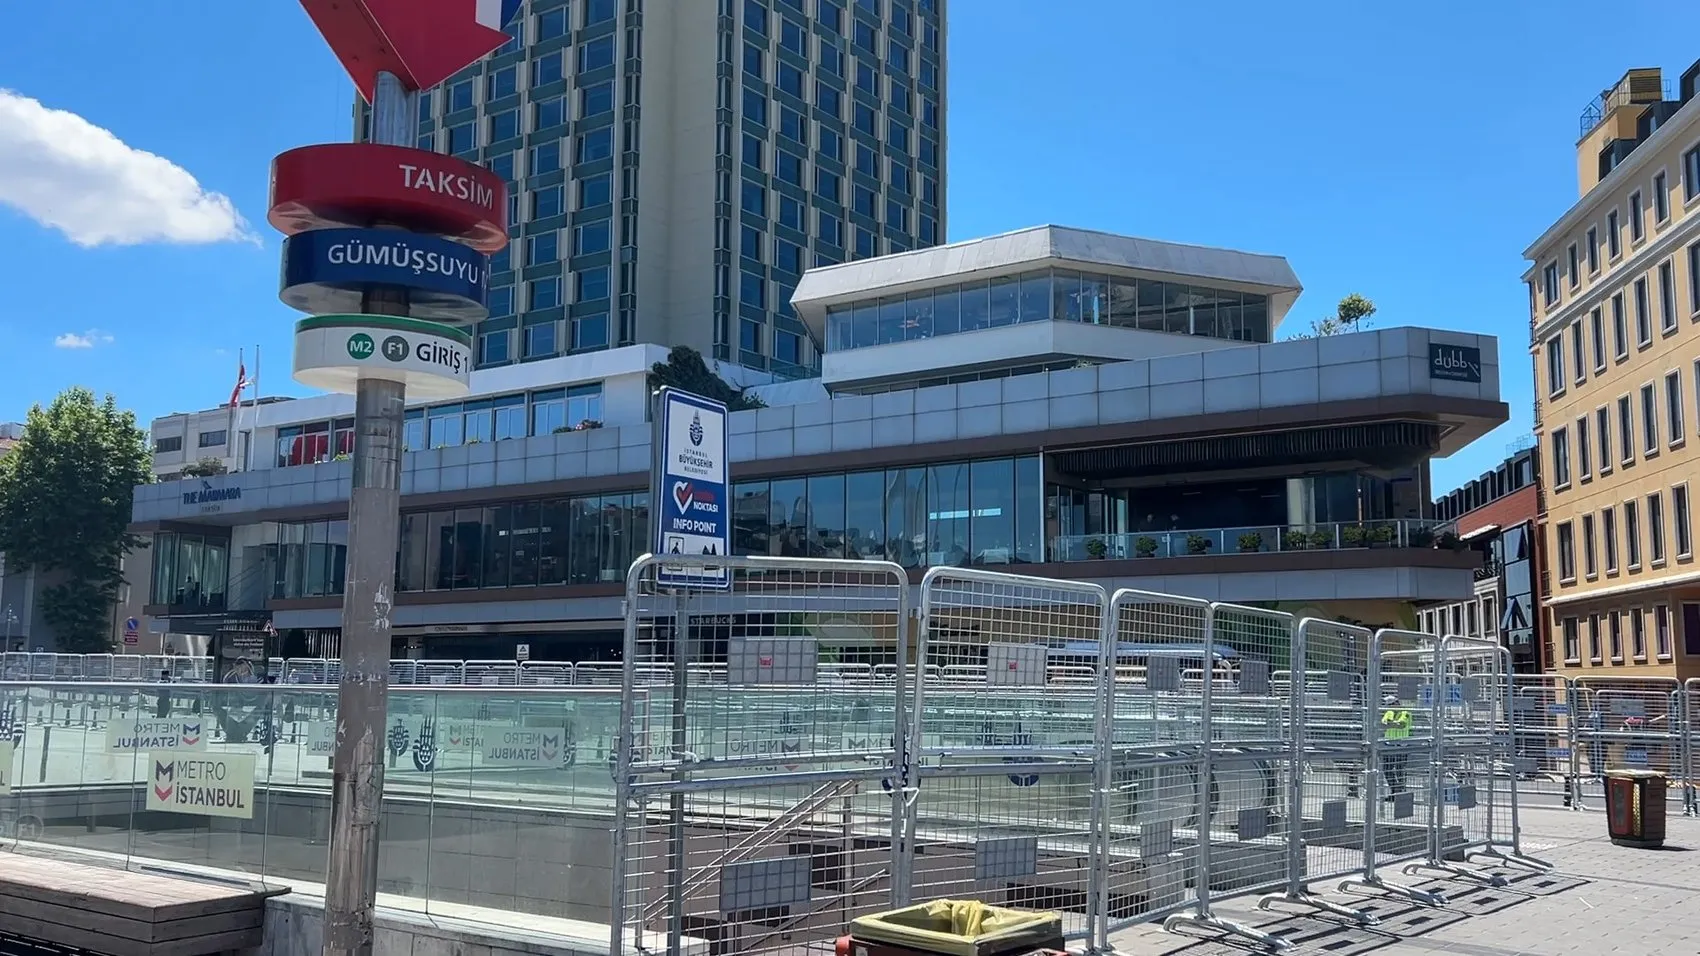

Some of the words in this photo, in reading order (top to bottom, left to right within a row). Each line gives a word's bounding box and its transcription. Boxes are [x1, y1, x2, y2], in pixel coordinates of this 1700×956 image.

[399, 164, 493, 210] TAKSİM
[328, 239, 478, 284] GÜMÜŞSUYU
[349, 341, 372, 353] M2
[387, 342, 404, 356] F1
[416, 341, 461, 375] GİRİŞ
[693, 501, 719, 513] NOKTASI
[673, 517, 693, 531] INFO
[693, 520, 717, 534] POINT
[176, 760, 224, 781] METRO
[175, 781, 245, 809] İSTANBUL
